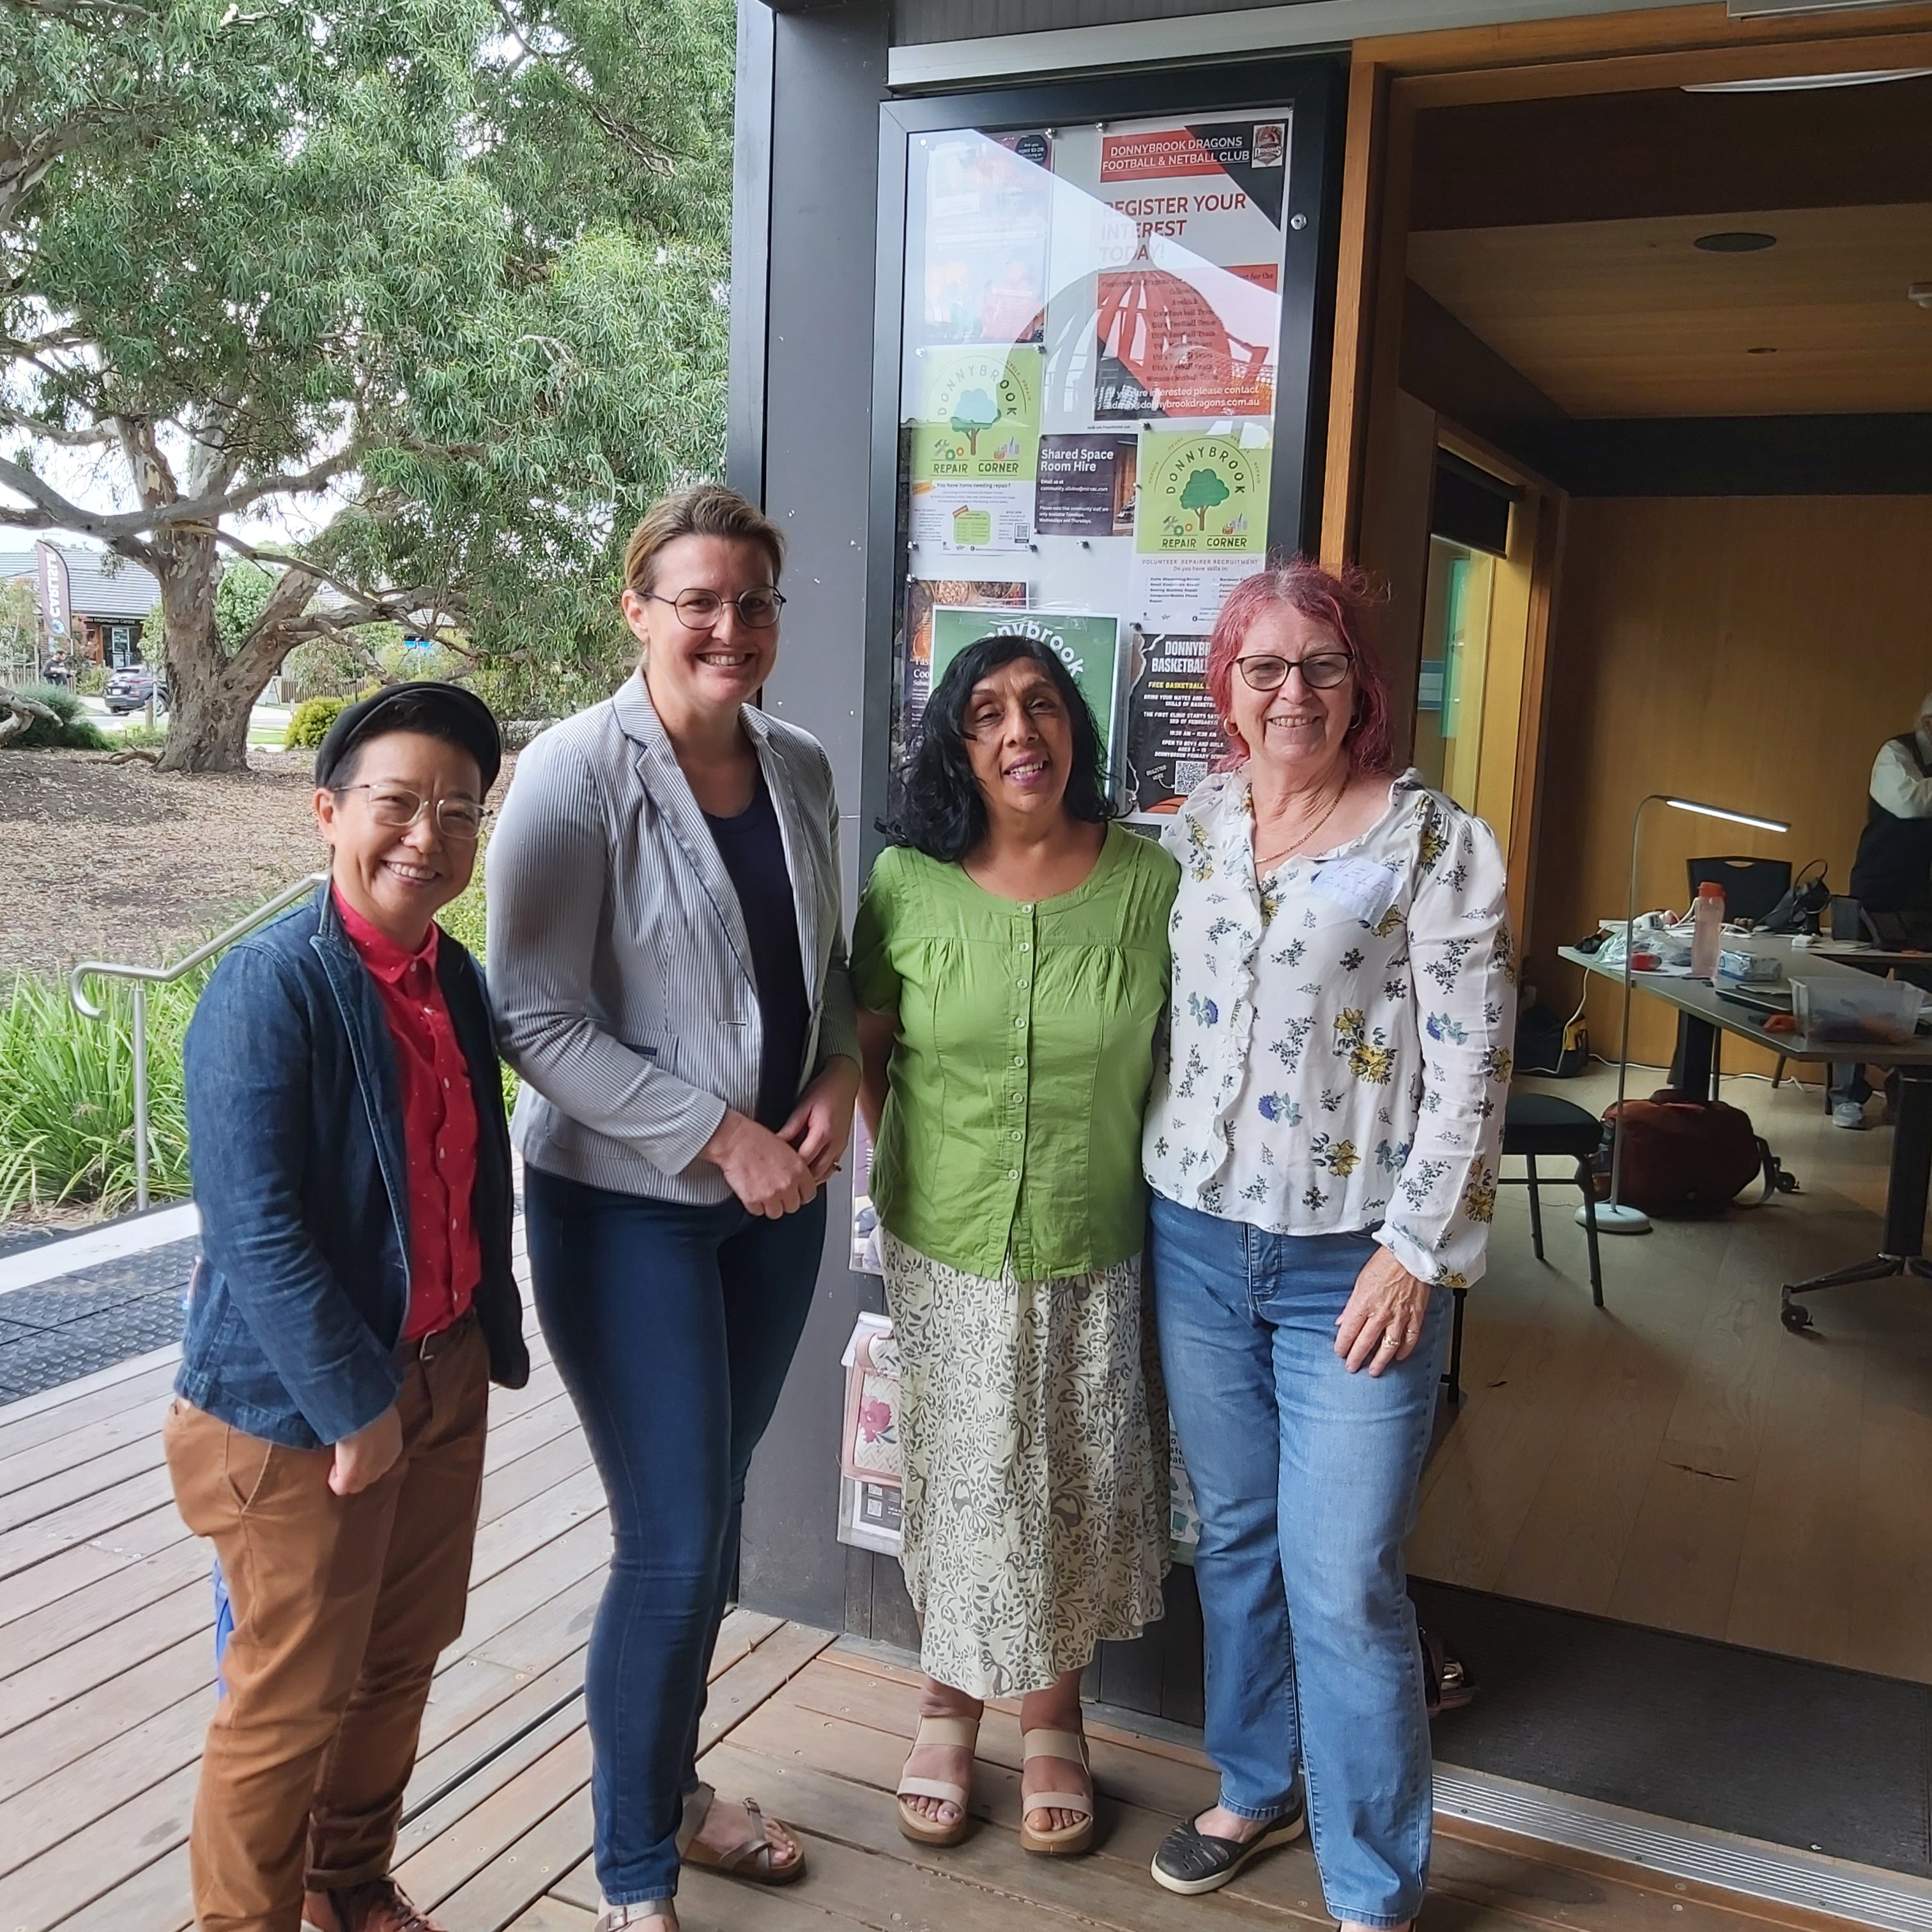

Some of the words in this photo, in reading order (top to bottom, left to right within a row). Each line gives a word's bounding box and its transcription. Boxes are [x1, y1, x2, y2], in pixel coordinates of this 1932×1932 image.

[1110, 140, 1186, 157] DONNYBROOK
[1188, 136, 1243, 150] DRAGONS
[1103, 157, 1156, 171] FOOTBALL
[1158, 157, 1165, 166] &
[1169, 153, 1217, 165] NETBALL
[1219, 150, 1250, 162] CLUB
[1103, 197, 1188, 217] REGISTER
[1193, 193, 1246, 212] YOUR
[1101, 220, 1187, 240] INTEREST
[1100, 244, 1164, 263] TODAY!
[937, 365, 1017, 415] DONNYBROOK
[1193, 386, 1223, 397] please
[1224, 385, 1260, 394] contact
[1041, 448, 1079, 460] Shared
[1080, 448, 1114, 462] Space
[933, 463, 968, 474] REPAIR
[978, 463, 1019, 473] CORNER
[1040, 461, 1071, 471] Room
[1073, 461, 1097, 471] Hire
[1166, 447, 1245, 494] DONNYBROOK
[1162, 539, 1197, 548] REPAIR
[1207, 538, 1247, 548] CORNER
